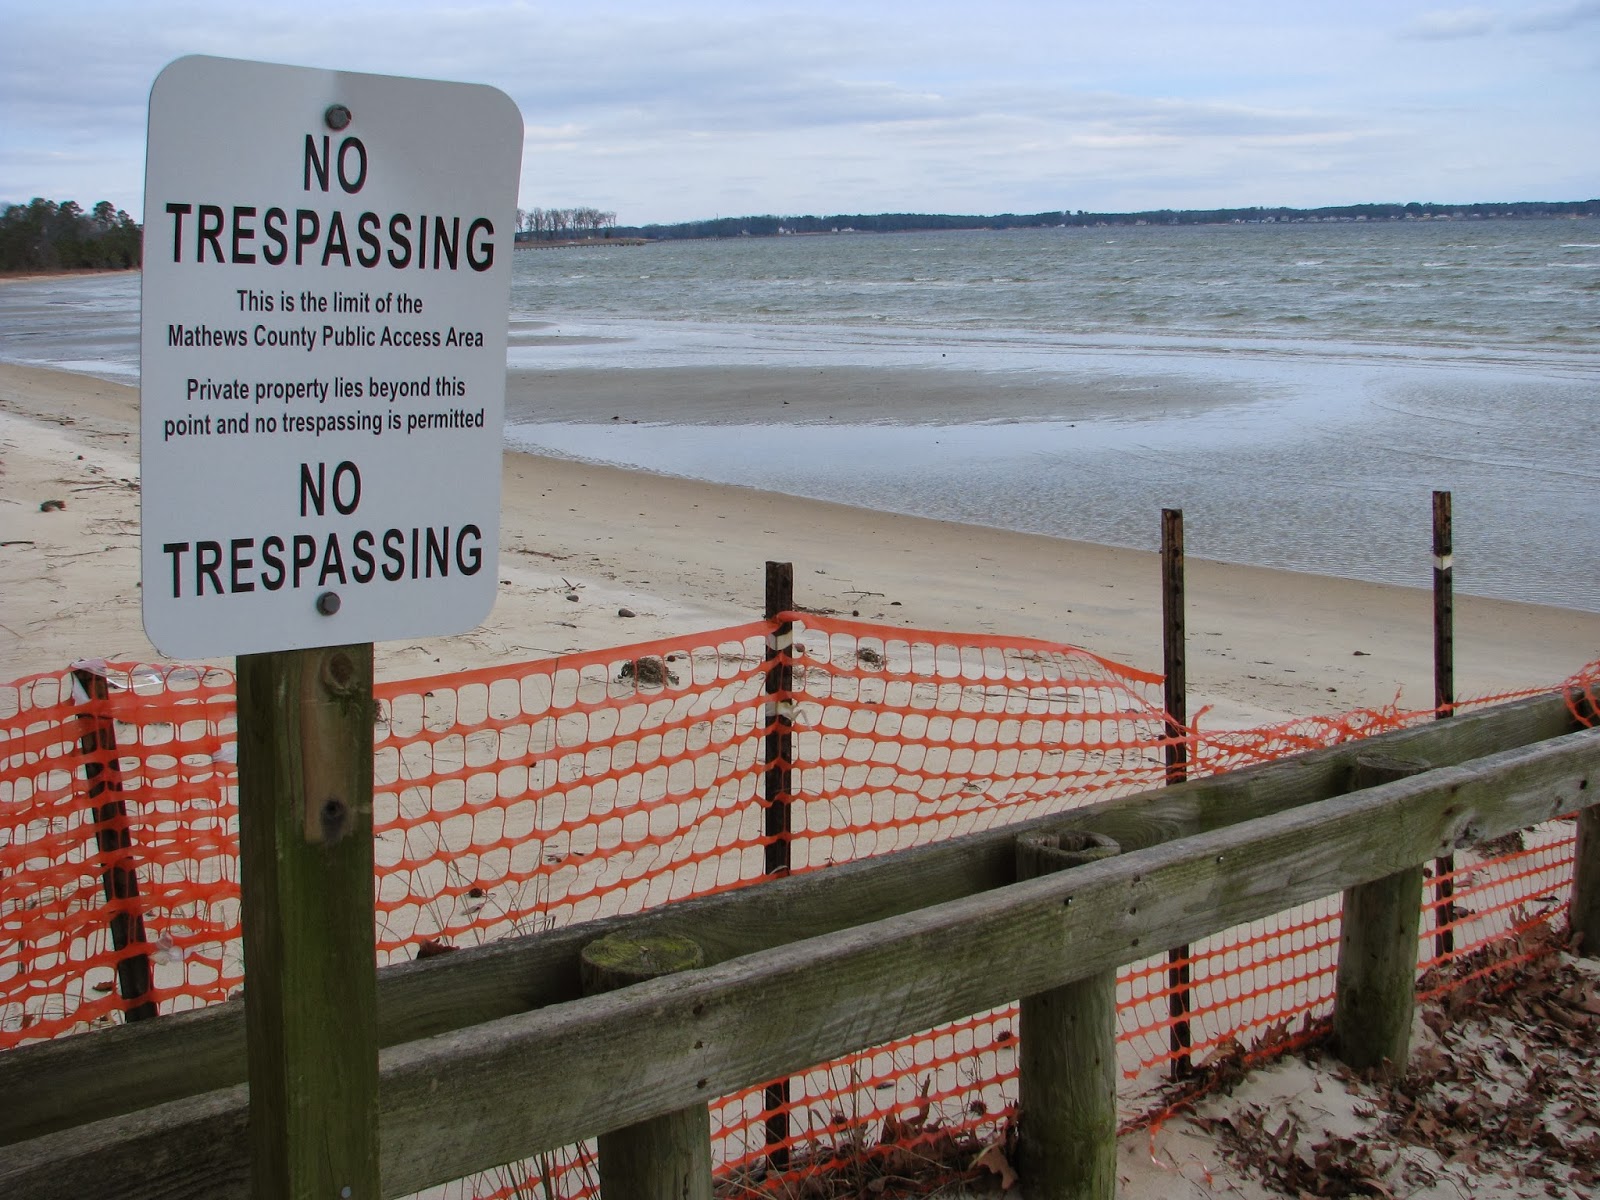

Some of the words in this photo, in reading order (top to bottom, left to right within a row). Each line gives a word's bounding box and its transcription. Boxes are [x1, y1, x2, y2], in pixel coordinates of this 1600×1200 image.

[303, 131, 368, 193] NO
[165, 202, 495, 271] TRESPASSING
[236, 288, 274, 311] This
[280, 290, 295, 311] is
[299, 291, 328, 312] the
[333, 290, 371, 312] limit
[375, 292, 393, 312] of
[396, 291, 423, 312] the
[168, 324, 247, 345] Mathews
[253, 324, 317, 351] County
[322, 324, 376, 345] Public
[379, 325, 441, 345] Access
[445, 326, 484, 346] Area
[187, 376, 250, 399] Private
[255, 380, 330, 403] property
[334, 375, 364, 396] lies
[368, 375, 431, 401] beyond
[435, 375, 466, 395] this
[164, 413, 212, 440] point
[216, 413, 249, 434] and
[255, 416, 277, 432] no
[282, 411, 384, 436] trespassing
[388, 408, 402, 428] is
[407, 407, 485, 433] permitted
[300, 459, 362, 516] NO
[162, 522, 482, 597] TRESPASSING
